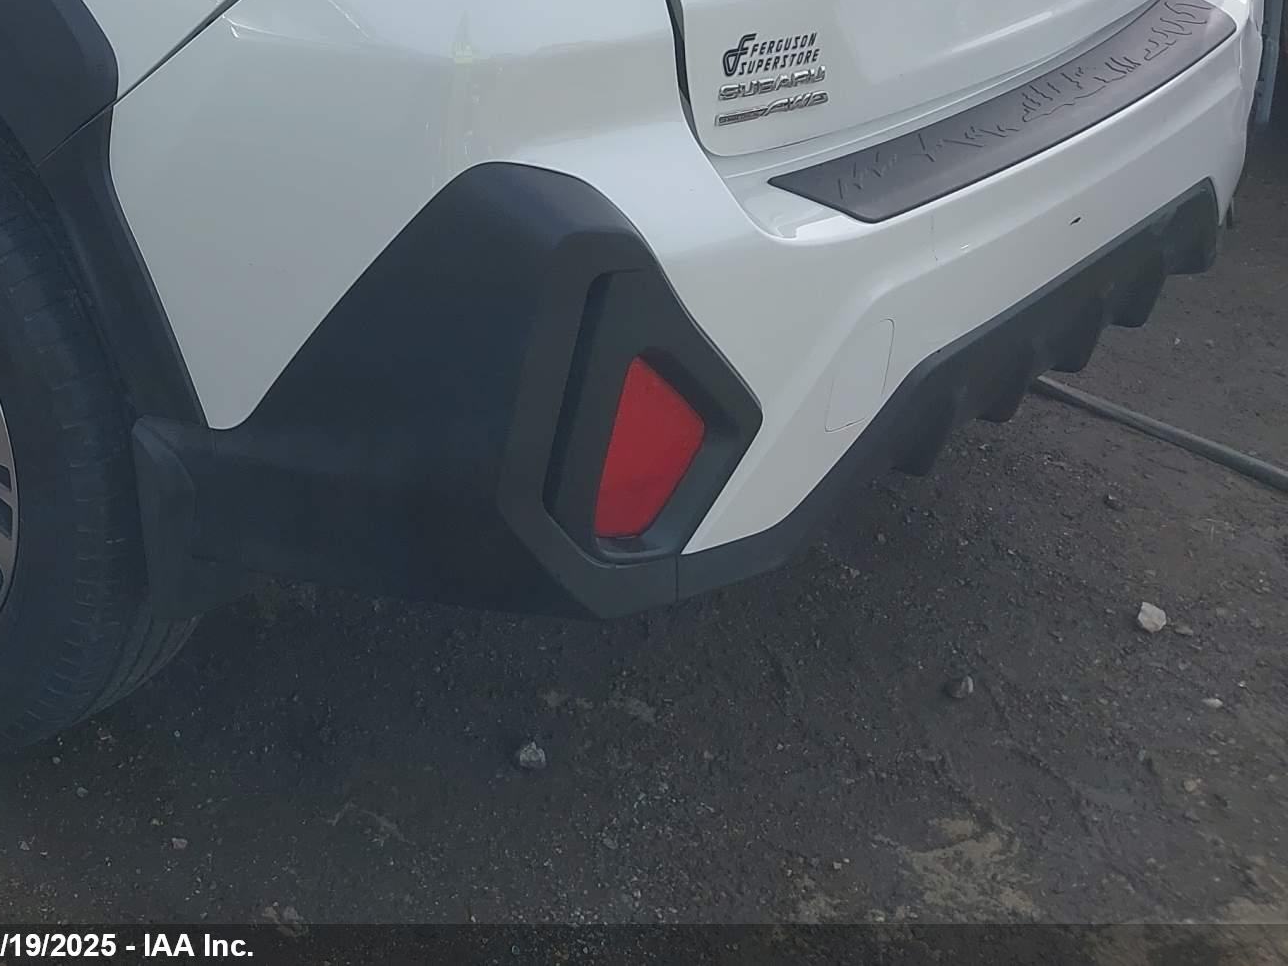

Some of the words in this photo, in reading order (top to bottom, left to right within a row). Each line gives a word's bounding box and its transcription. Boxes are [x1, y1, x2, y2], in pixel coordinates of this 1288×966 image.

[750, 31, 817, 57] FERGUSON
[738, 48, 820, 75] SUPERSTORE
[719, 66, 826, 100] SUBARU
